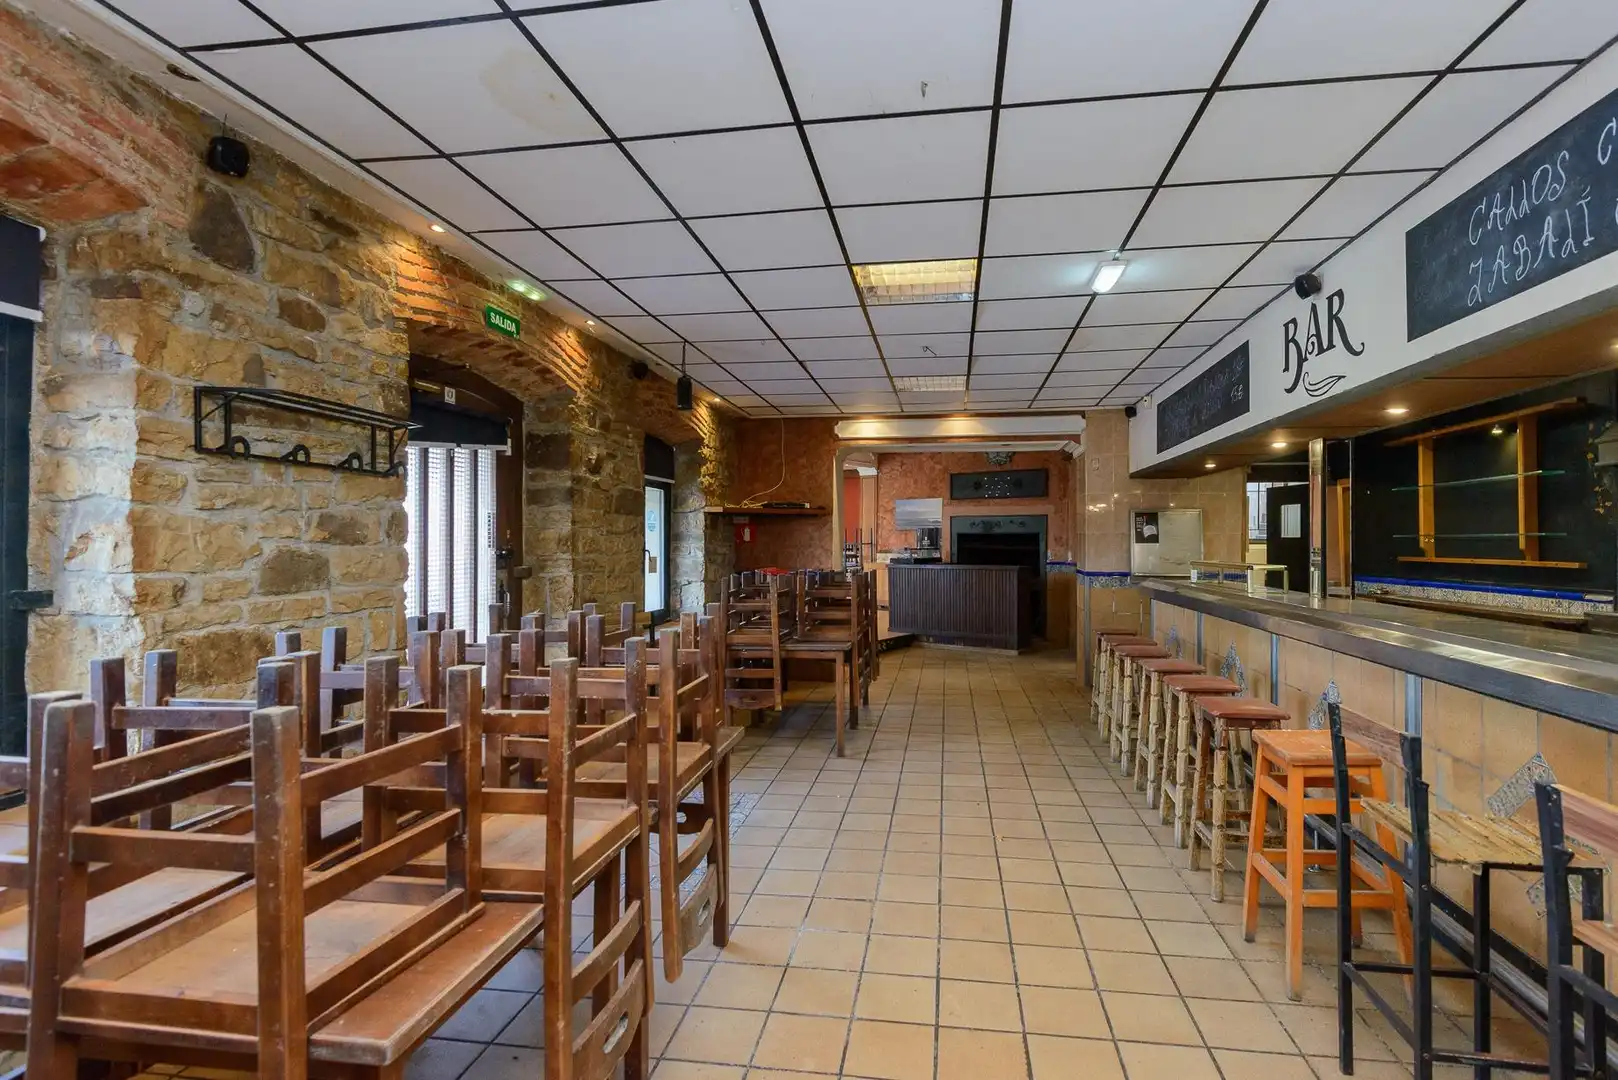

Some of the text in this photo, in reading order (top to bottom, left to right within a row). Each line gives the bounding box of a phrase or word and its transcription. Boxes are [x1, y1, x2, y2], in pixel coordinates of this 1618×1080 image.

[1468, 150, 1570, 246] CALLOS
[490, 311, 517, 334] SALIDA
[1282, 288, 1365, 394] BAR
